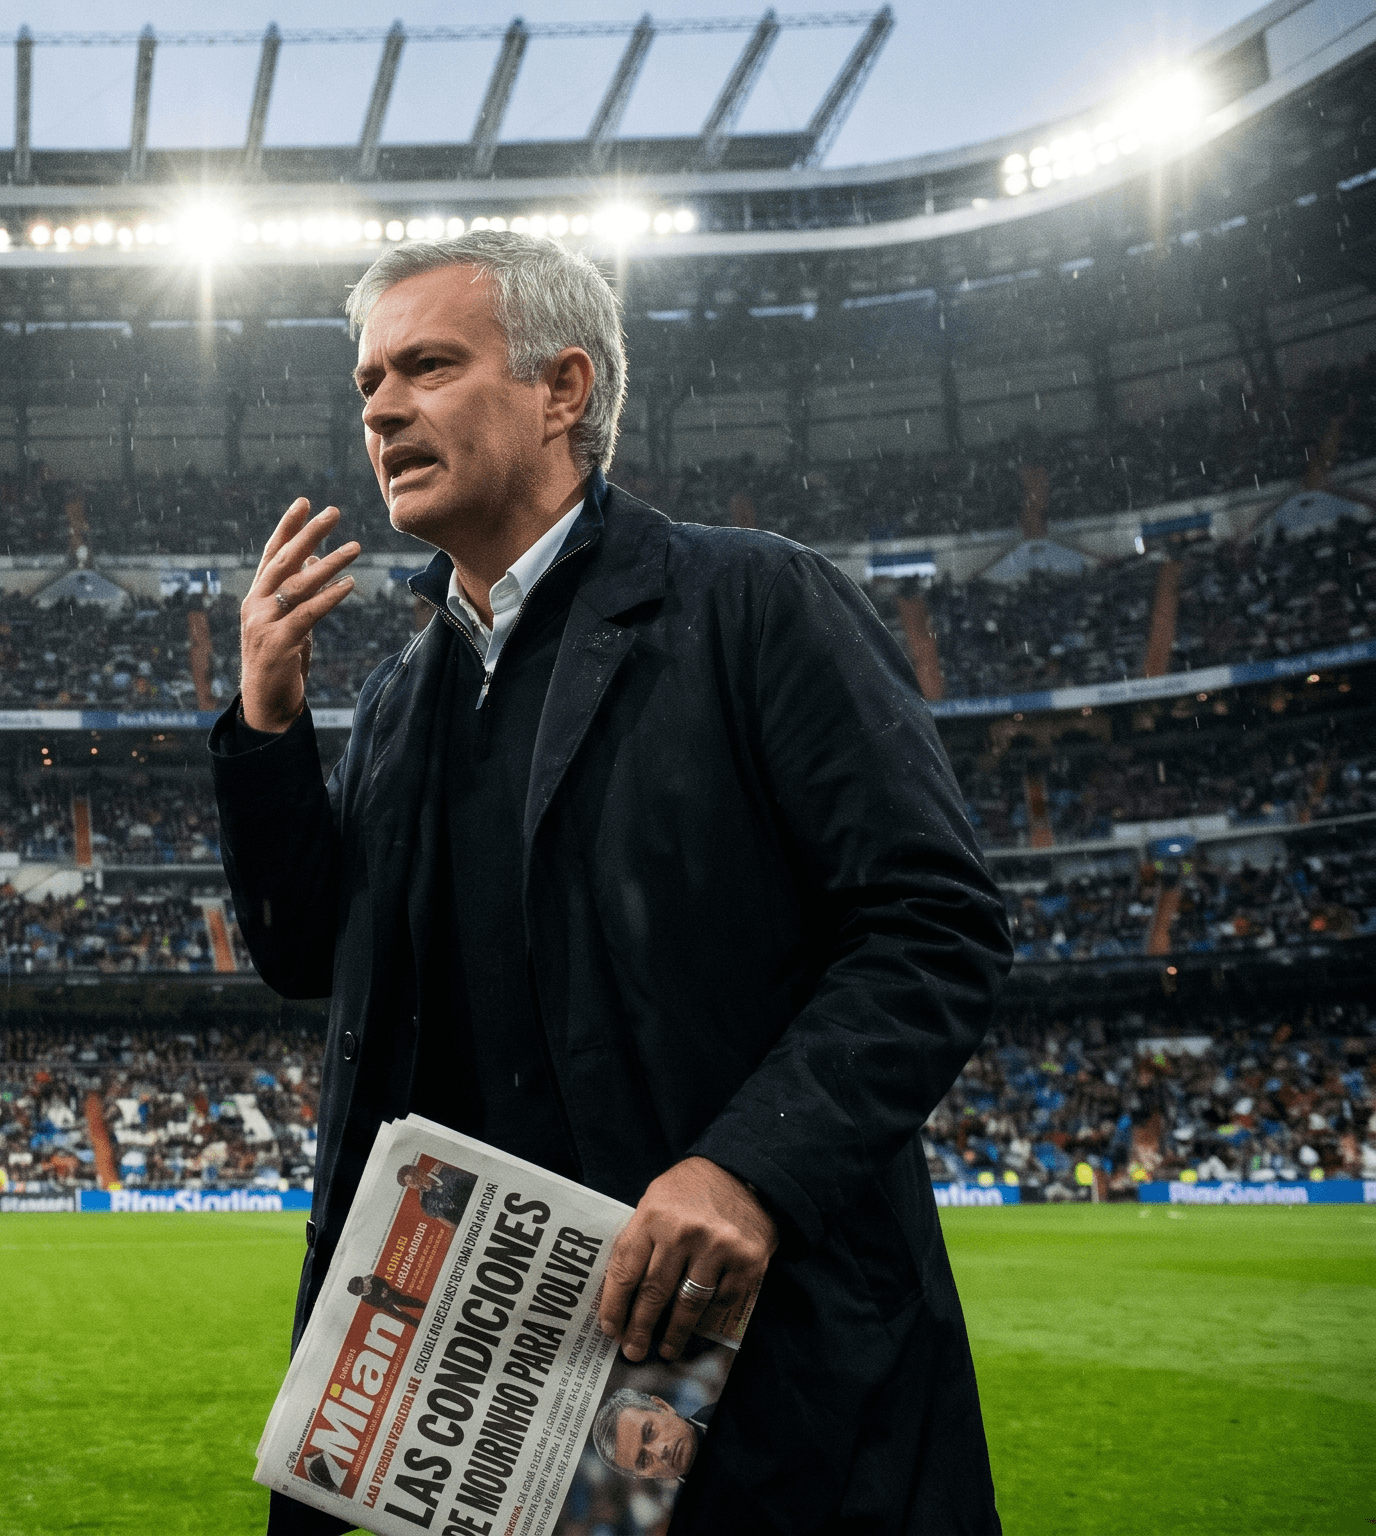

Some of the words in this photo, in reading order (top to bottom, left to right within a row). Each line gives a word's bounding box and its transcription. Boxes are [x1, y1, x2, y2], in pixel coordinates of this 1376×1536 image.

[417, 1192, 551, 1447] CONDICIONES
[527, 1226, 604, 1322] VOLVER
[308, 1313, 406, 1464] Mian
[502, 1318, 566, 1388] PARA
[383, 1447, 452, 1530] LAS
[455, 1382, 539, 1517] MOURINHO
